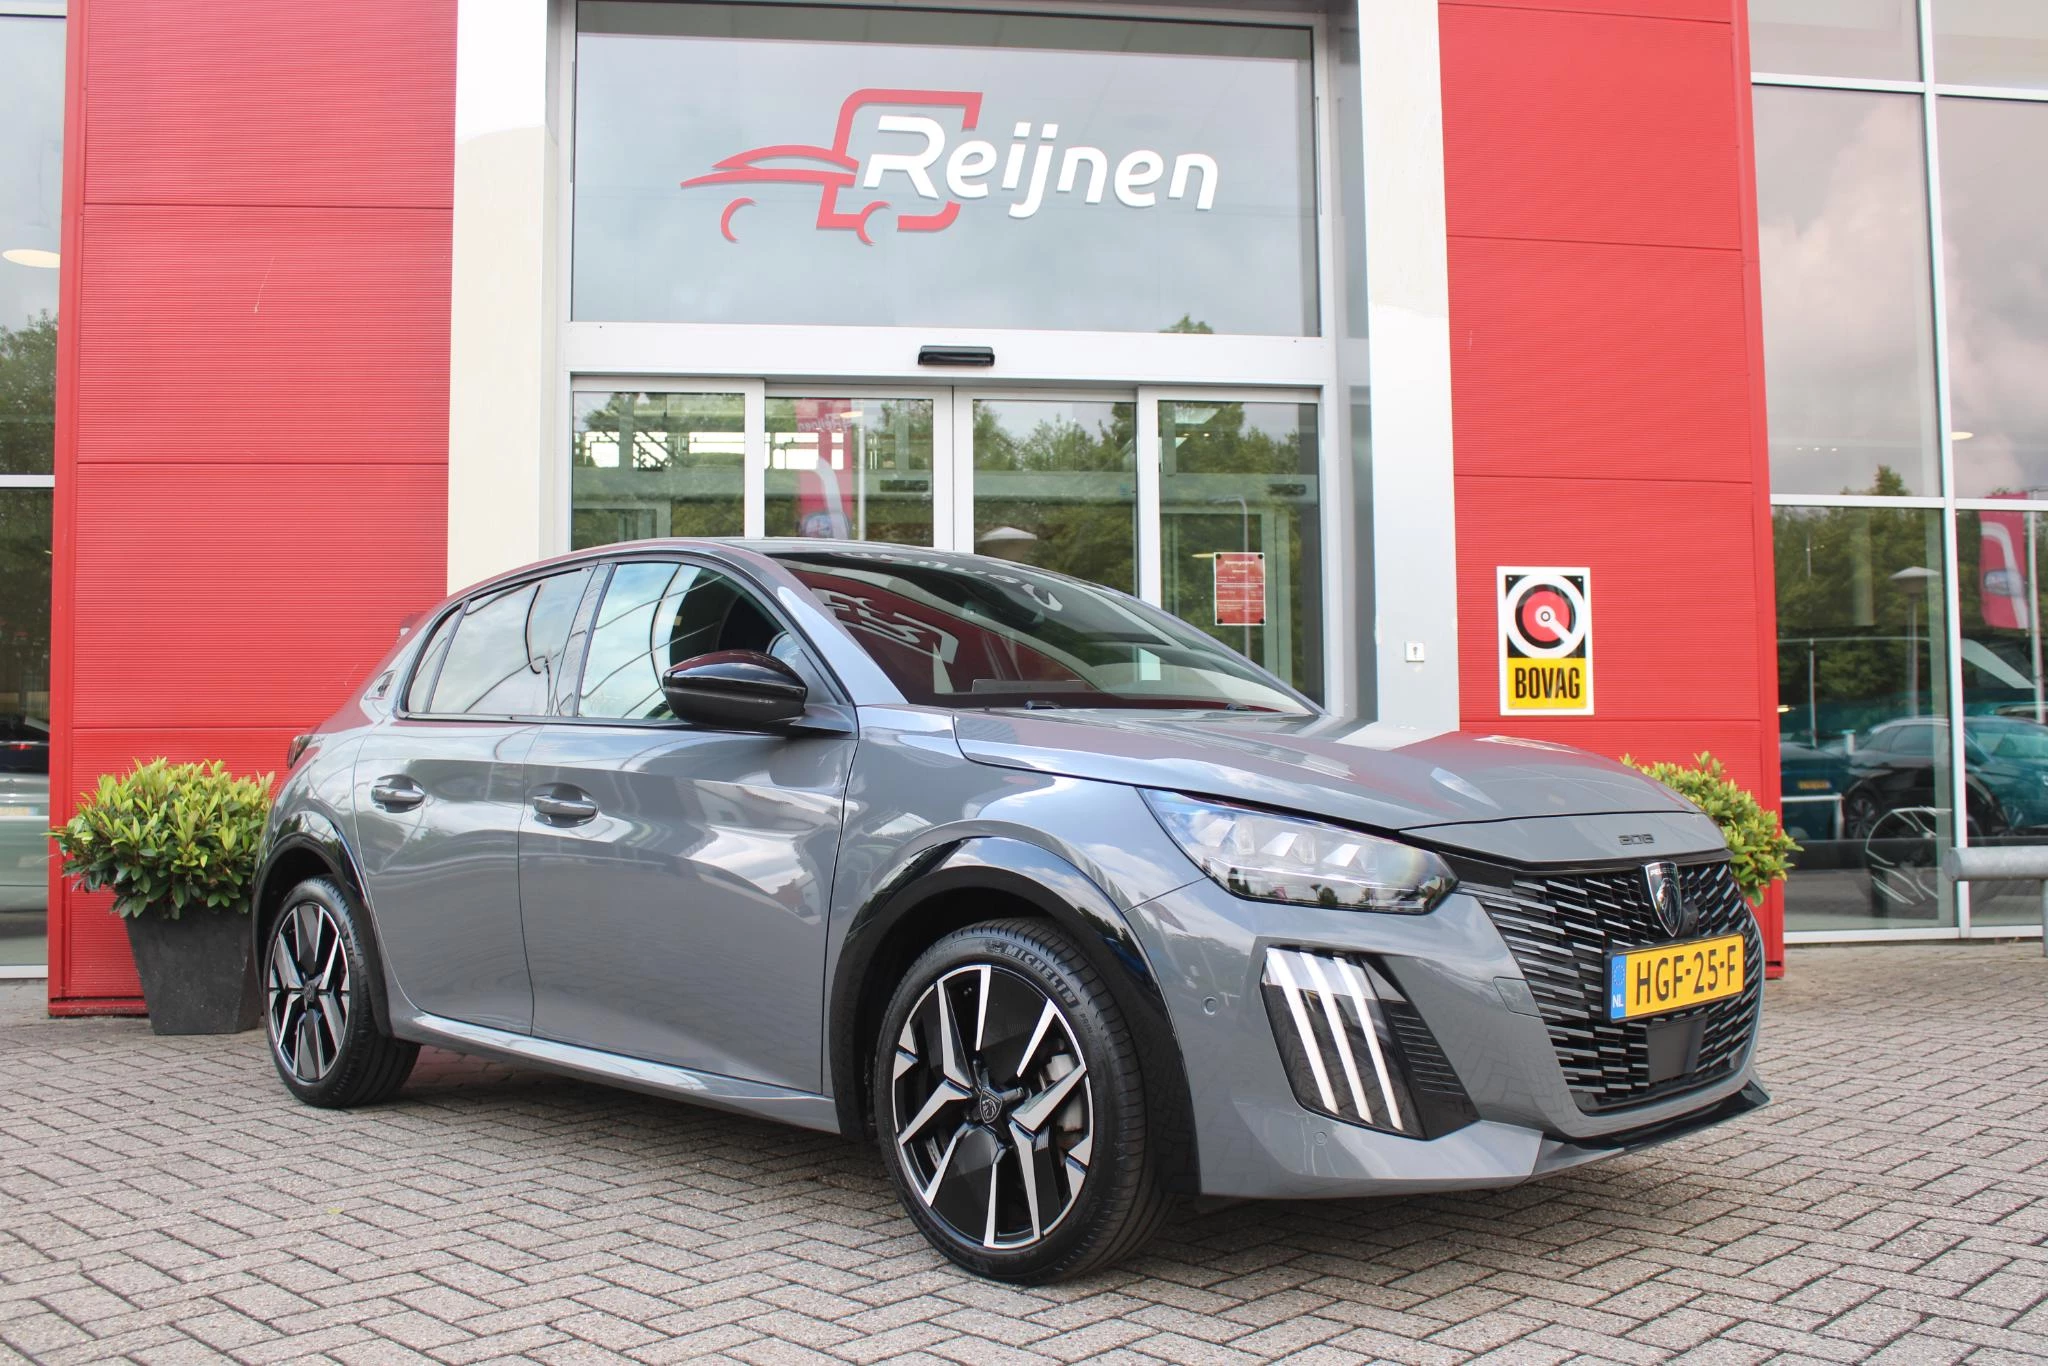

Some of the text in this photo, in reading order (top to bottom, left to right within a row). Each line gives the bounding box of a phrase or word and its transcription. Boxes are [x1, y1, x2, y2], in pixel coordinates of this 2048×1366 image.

[863, 115, 1219, 219] Reijnen
[1515, 667, 1580, 699] BOVAG
[1004, 944, 1077, 1005] MICHELIN
[1612, 994, 1624, 1008] NL
[1636, 945, 1737, 1006] HGF-25-F
